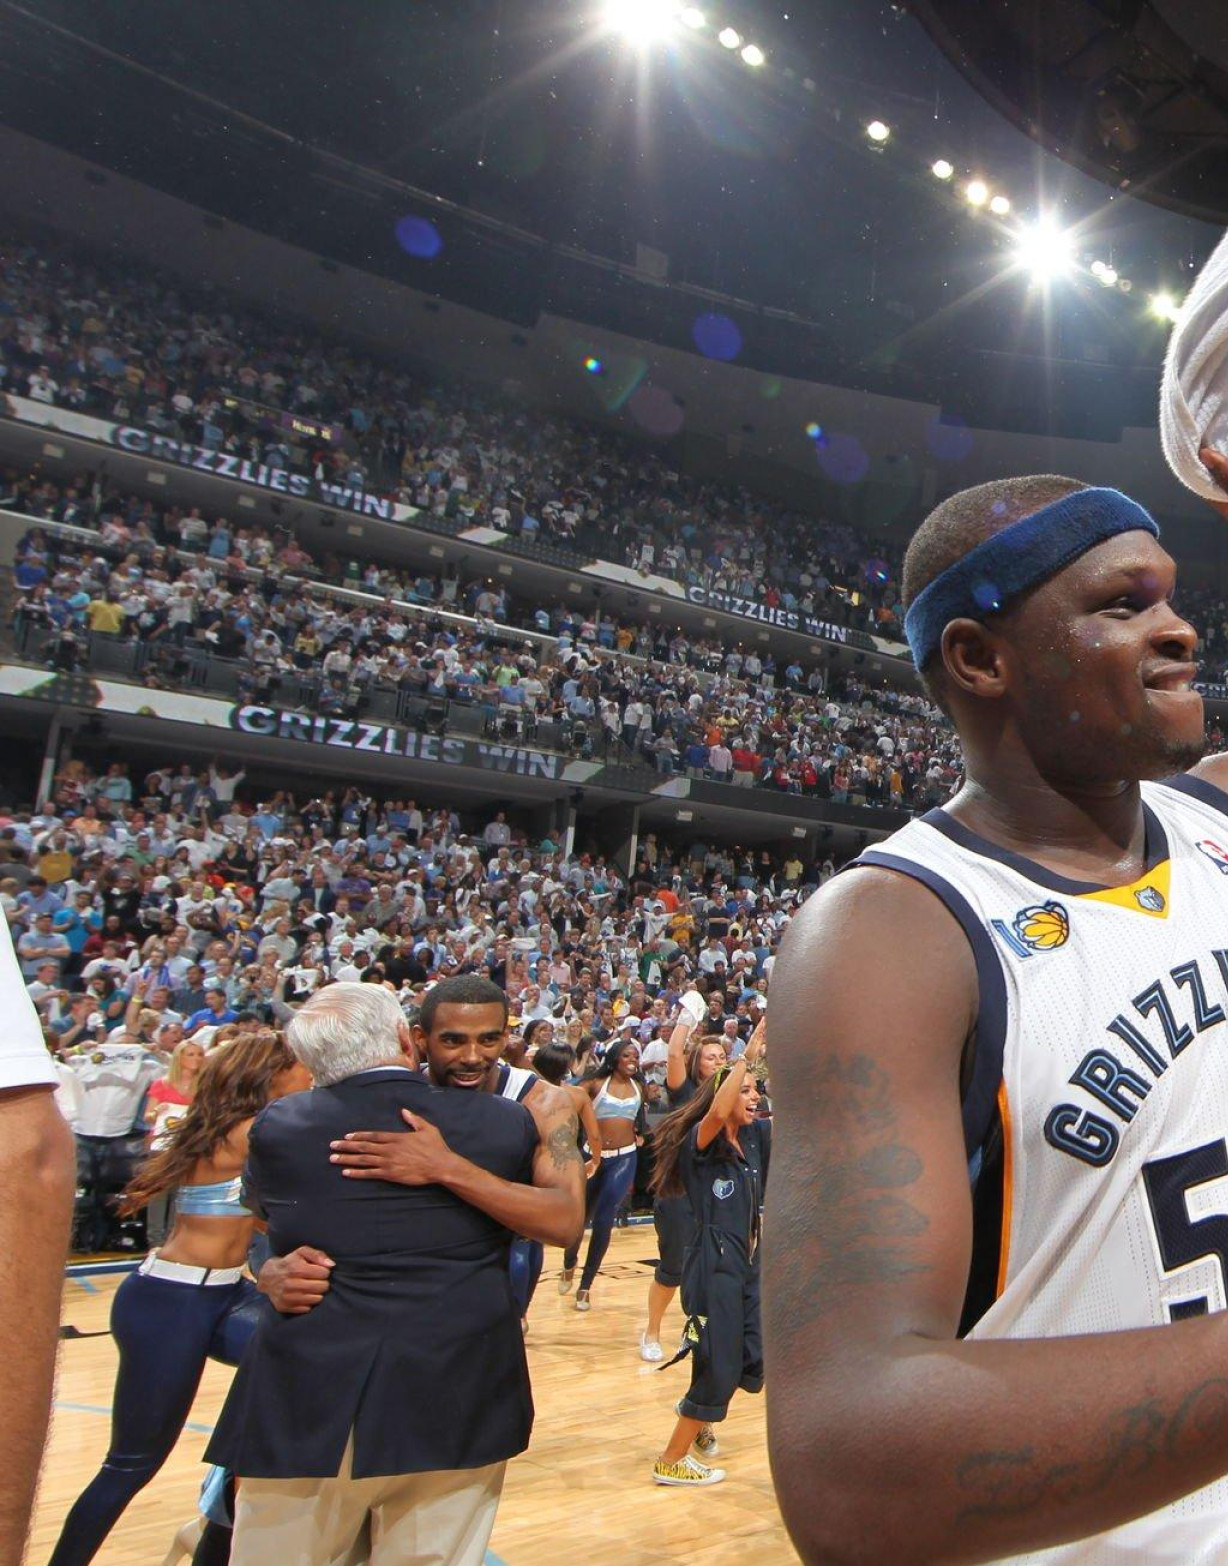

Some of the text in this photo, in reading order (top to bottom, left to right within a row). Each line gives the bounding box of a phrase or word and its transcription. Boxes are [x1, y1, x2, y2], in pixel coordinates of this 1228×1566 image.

[118, 426, 391, 518] GRIZZLIES WIN
[688, 587, 847, 643] GRIZZLIES WIN
[238, 705, 557, 779] GRIZZLIES WIN
